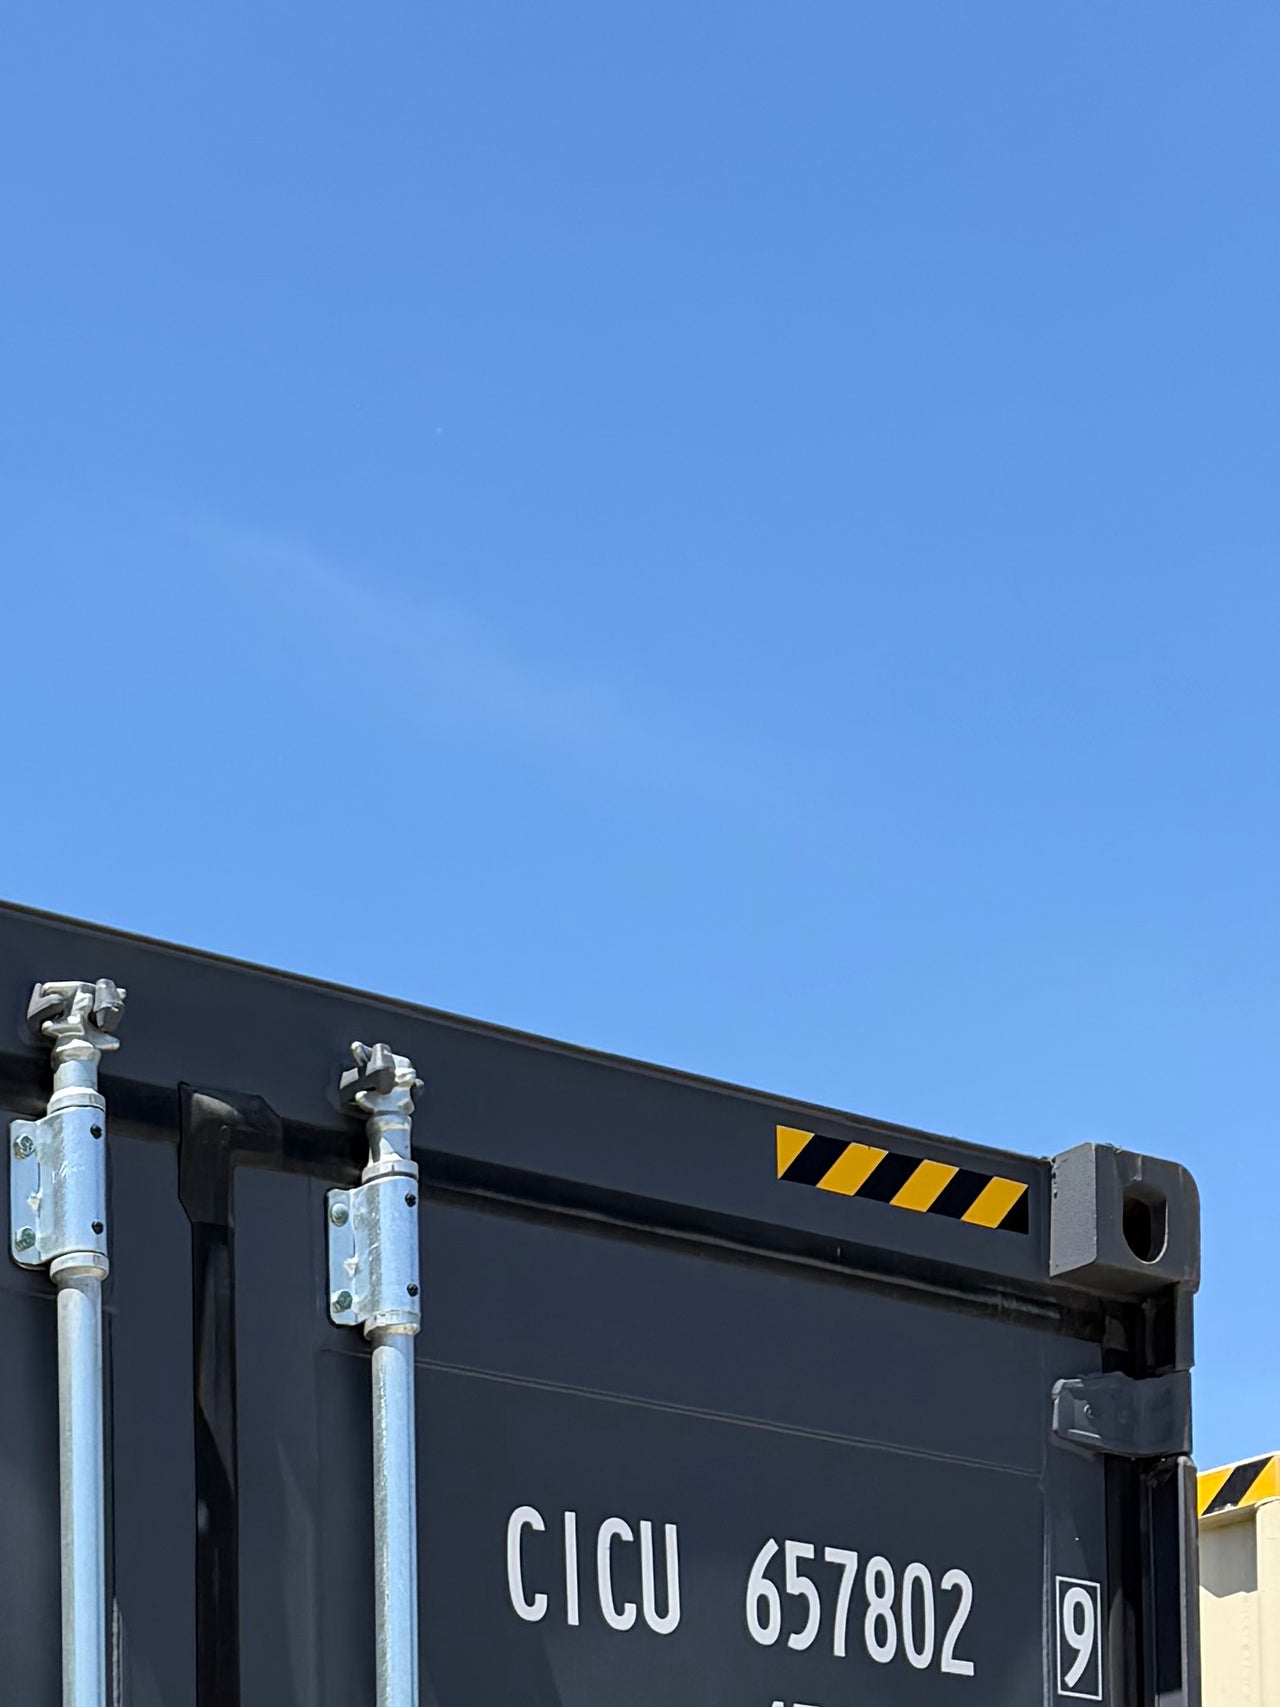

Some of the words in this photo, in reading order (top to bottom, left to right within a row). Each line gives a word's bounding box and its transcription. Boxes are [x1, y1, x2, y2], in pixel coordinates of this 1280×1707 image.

[508, 1506, 681, 1635] CICU
[746, 1539, 975, 1677] 657802
[1064, 1586, 1095, 1687] 9
